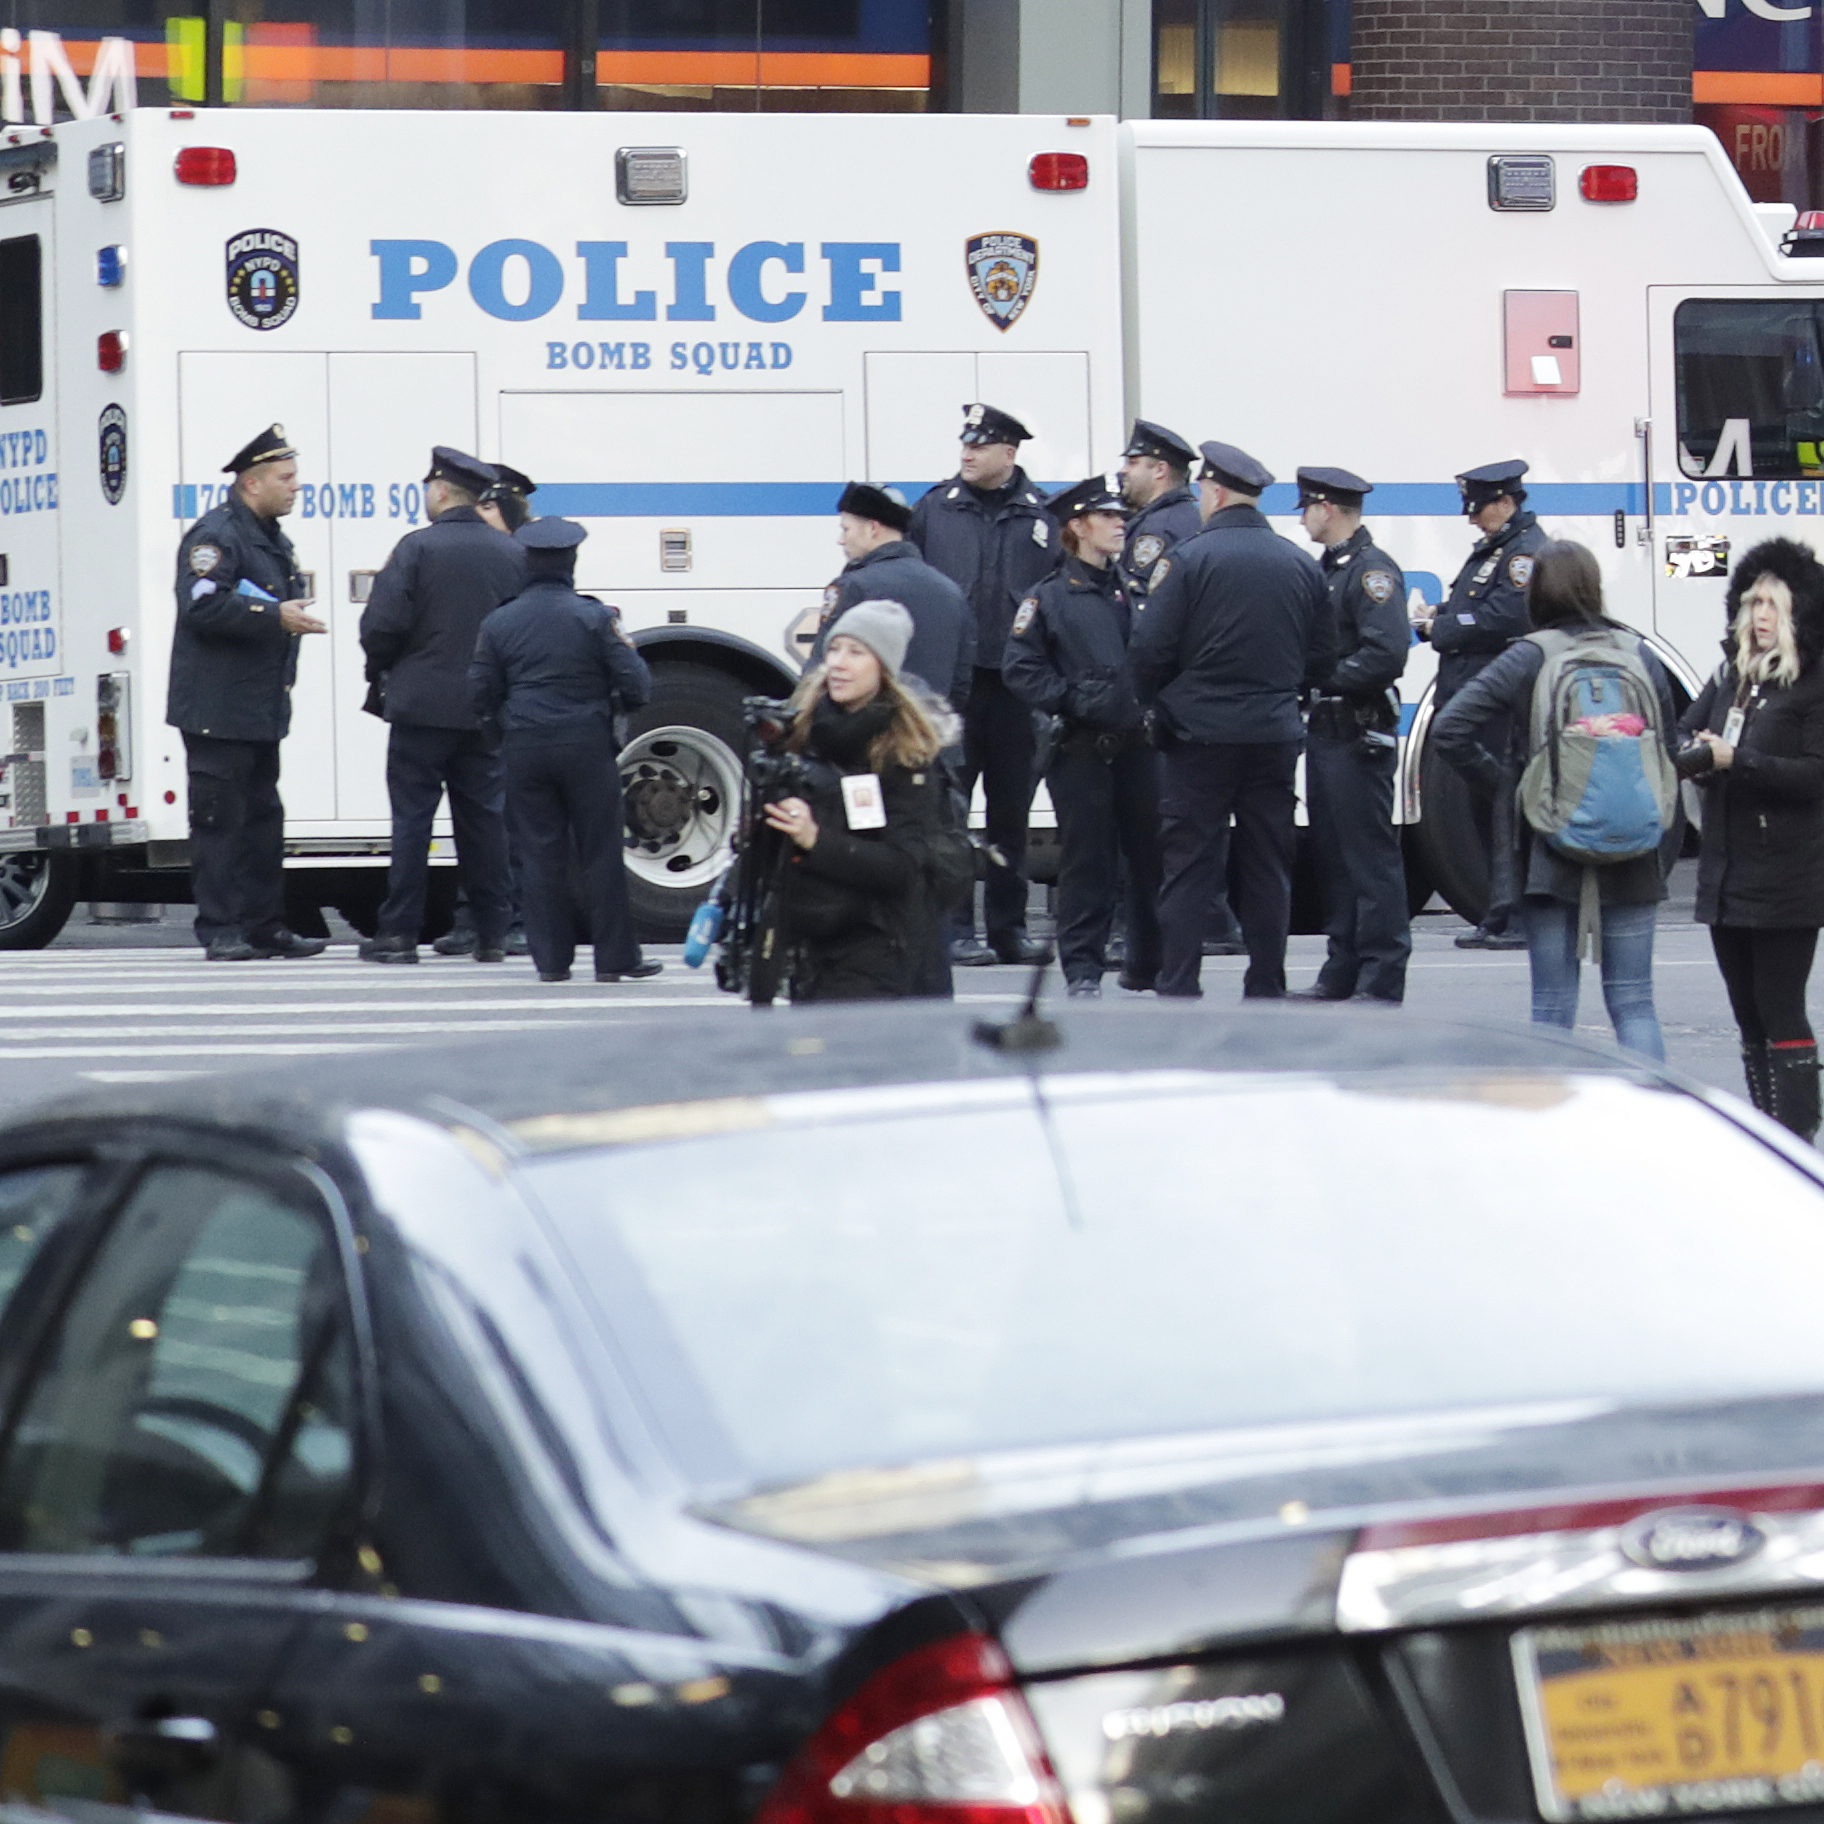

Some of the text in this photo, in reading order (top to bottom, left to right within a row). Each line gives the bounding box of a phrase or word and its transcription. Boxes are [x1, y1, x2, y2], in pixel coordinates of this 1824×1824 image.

[228, 232, 298, 262] POLICE
[244, 257, 282, 272] NYPD
[370, 238, 902, 323] POLICE
[229, 296, 298, 329] BOMB SQUAD
[546, 341, 793, 376] BOMB SQUAD
[301, 483, 376, 519] BOMB
[1675, 481, 1818, 516] POLICE
[1, 590, 51, 625] BOMB
